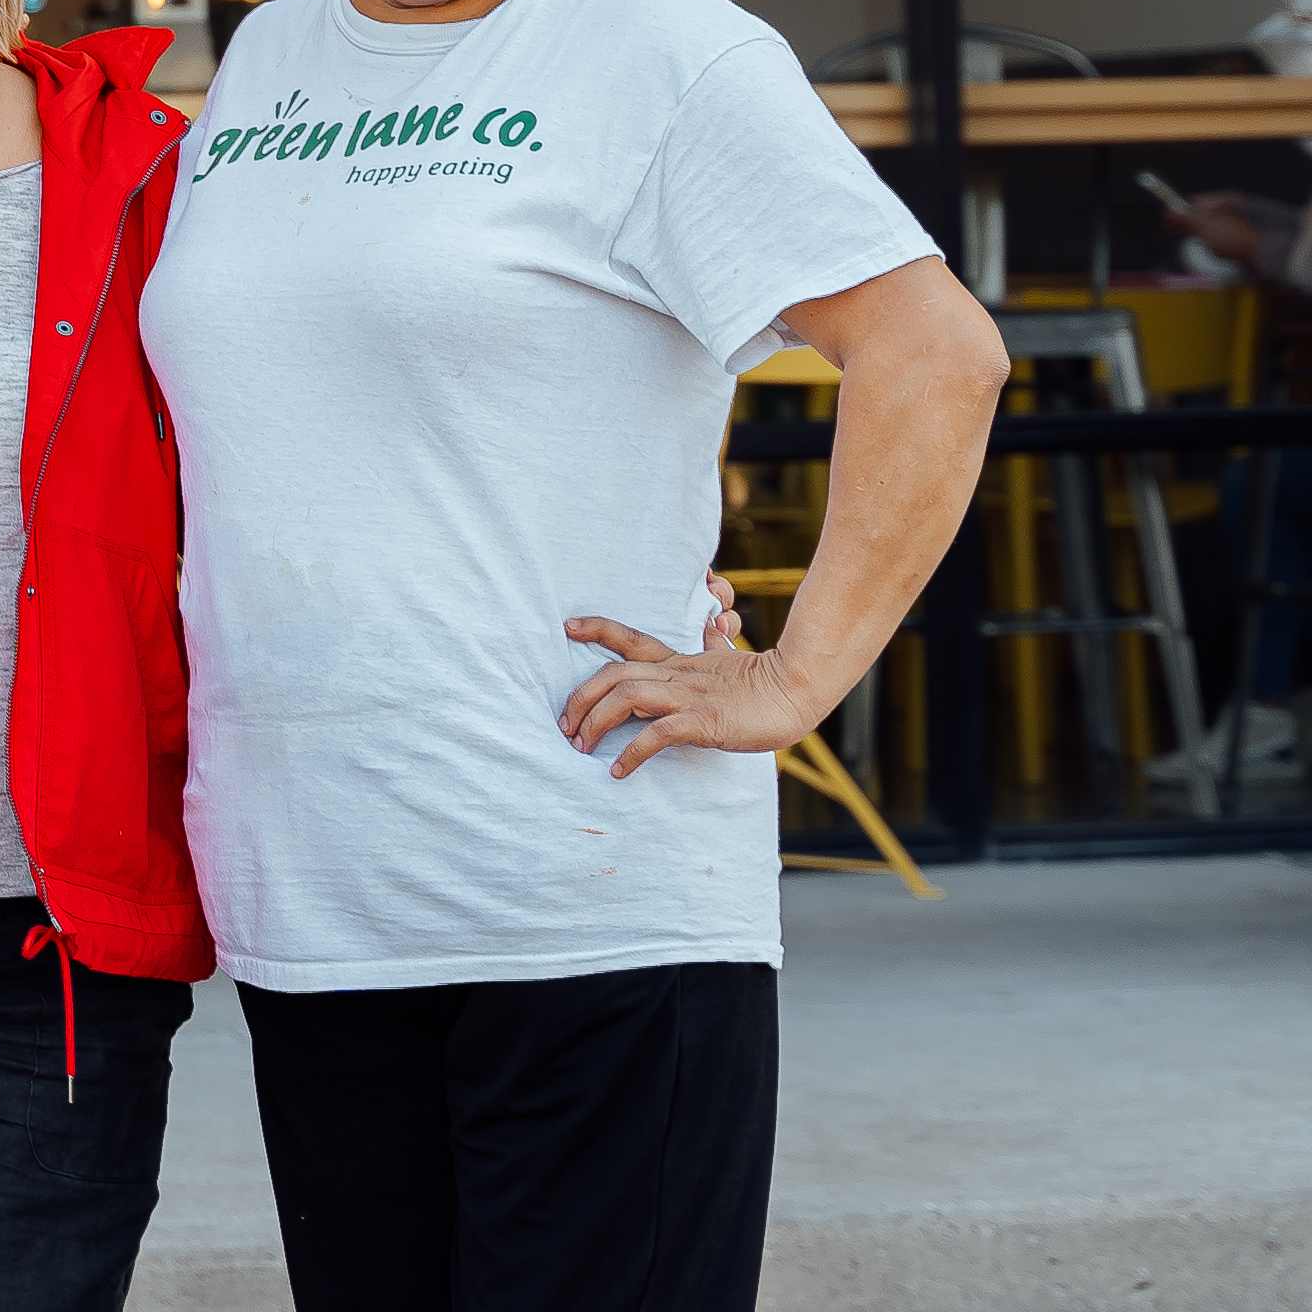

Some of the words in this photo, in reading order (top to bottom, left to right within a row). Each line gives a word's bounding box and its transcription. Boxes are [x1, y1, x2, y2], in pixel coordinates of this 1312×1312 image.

[192, 121, 344, 184] green
[343, 102, 464, 158] lane
[472, 106, 543, 152] co.
[344, 165, 422, 186] happy
[428, 156, 514, 184] eating
